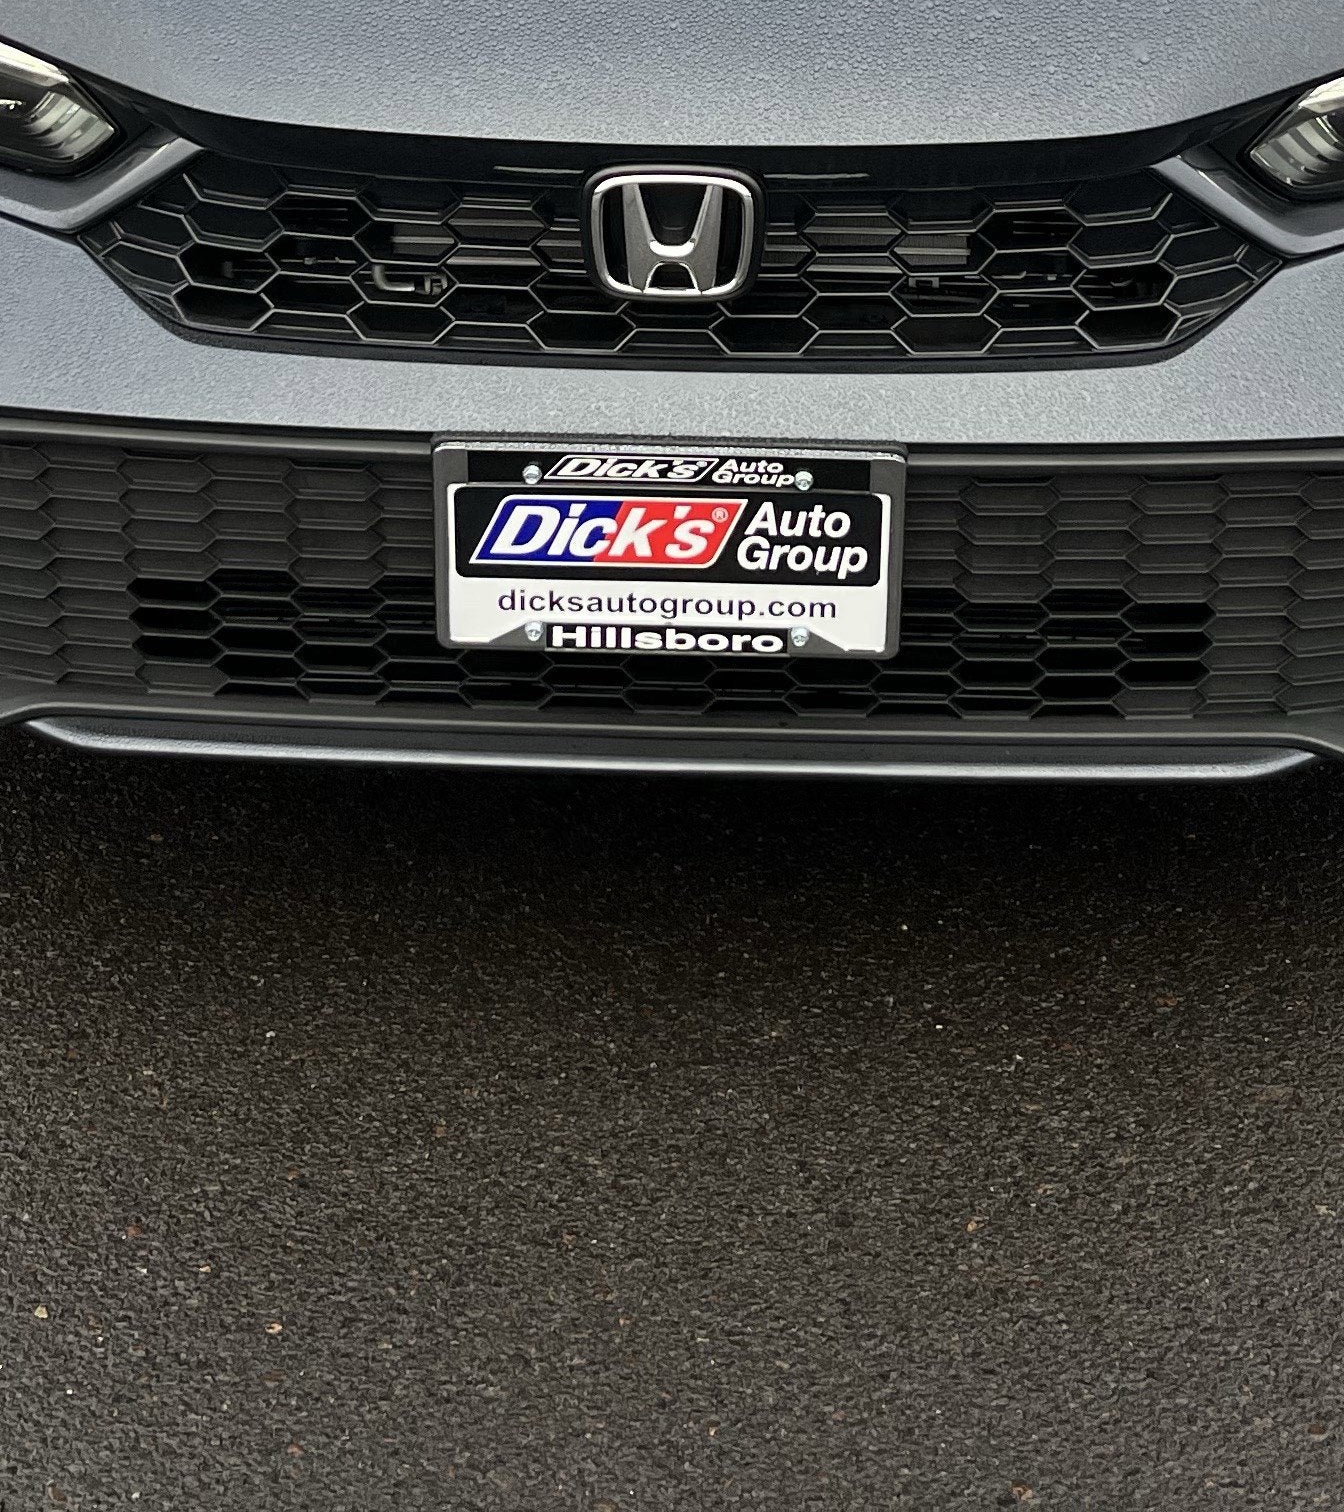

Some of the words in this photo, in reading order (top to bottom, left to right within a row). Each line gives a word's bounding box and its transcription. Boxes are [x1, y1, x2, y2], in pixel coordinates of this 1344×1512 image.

[711, 471, 795, 488] Group
[716, 458, 784, 474] Auto
[744, 501, 851, 538] Auto
[737, 536, 868, 579] Group
[498, 589, 837, 620] dicksautogroup.com
[552, 624, 784, 653] Hillsboro
